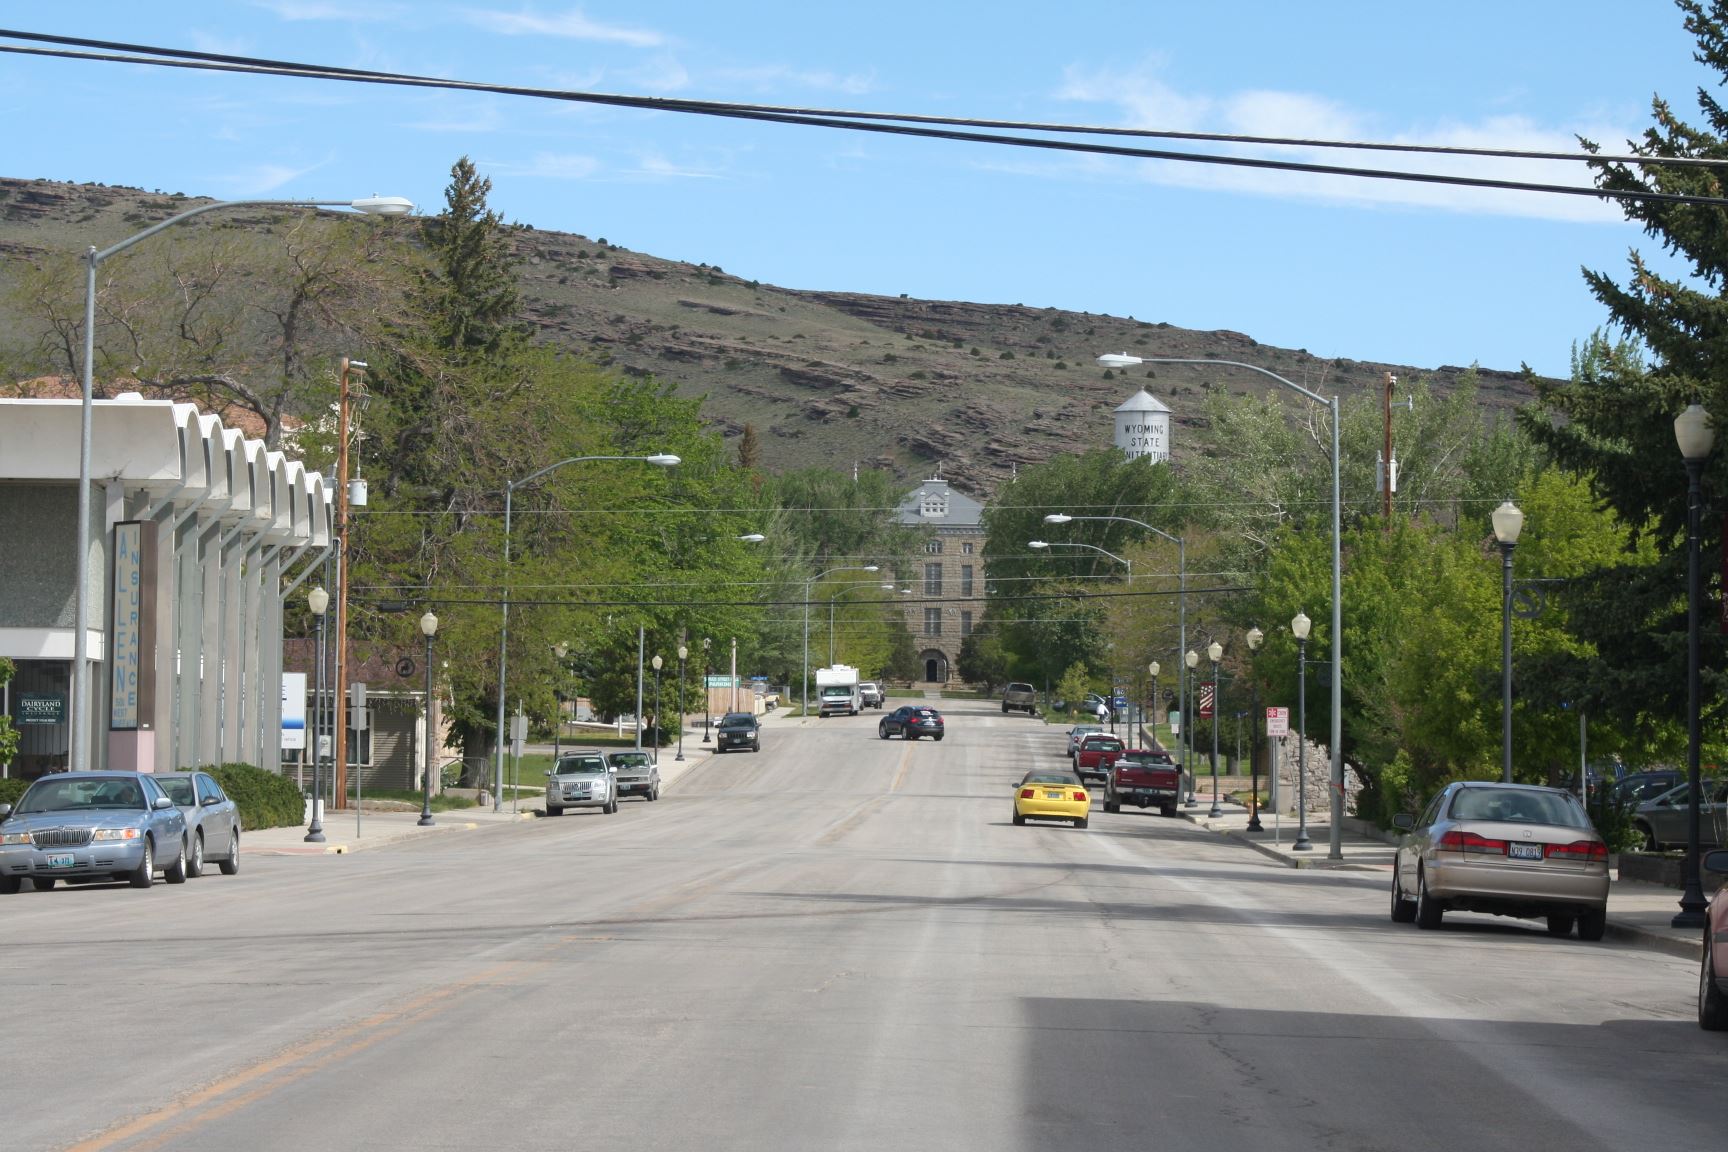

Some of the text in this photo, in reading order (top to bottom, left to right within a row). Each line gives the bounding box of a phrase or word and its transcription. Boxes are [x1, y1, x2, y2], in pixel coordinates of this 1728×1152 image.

[1125, 424, 1163, 434] WYOMING
[1131, 438, 1159, 447] STATE
[117, 531, 127, 693] ALLEN
[128, 532, 138, 705] INSURANCE
